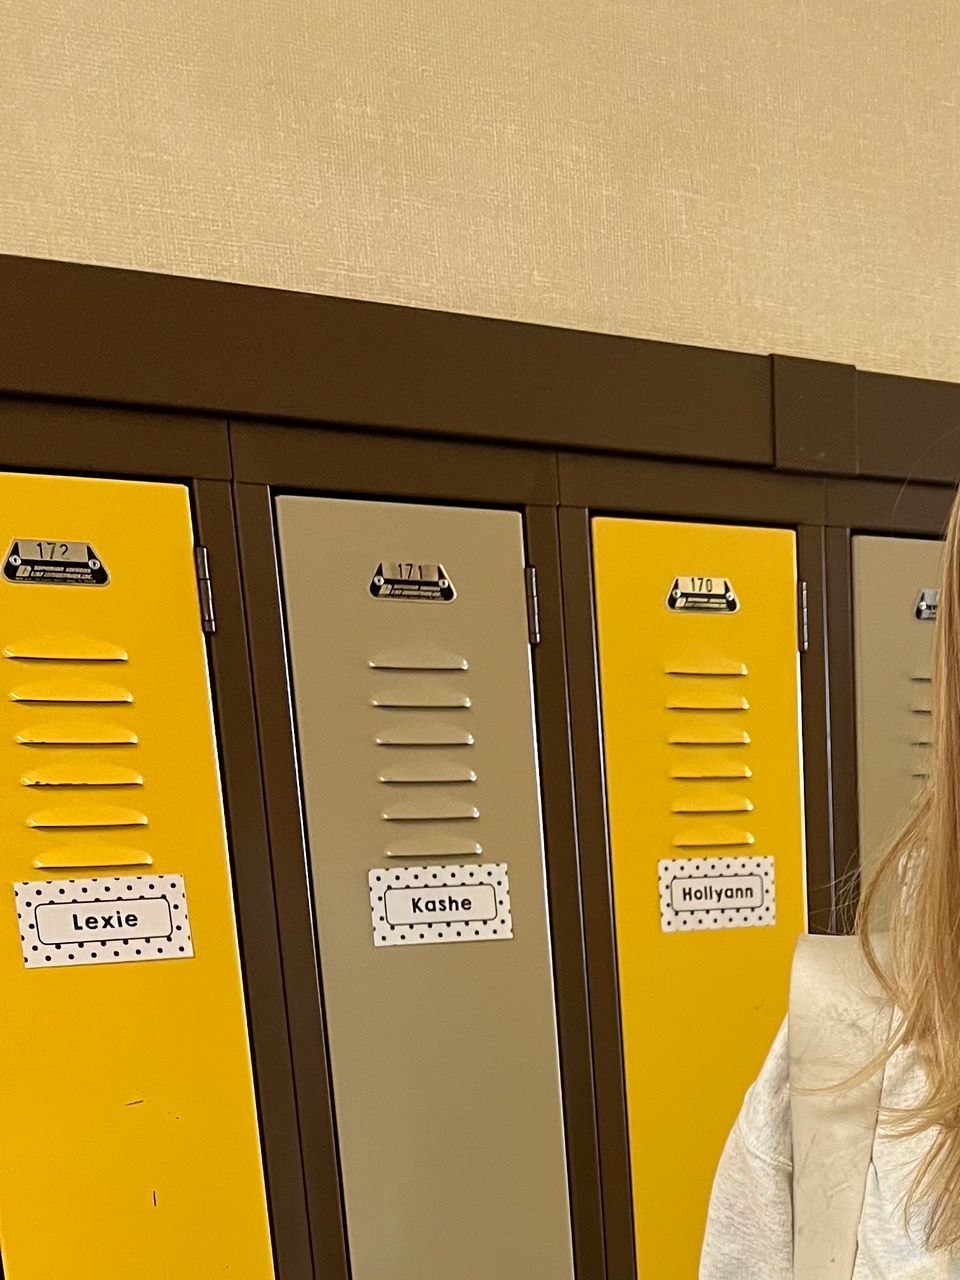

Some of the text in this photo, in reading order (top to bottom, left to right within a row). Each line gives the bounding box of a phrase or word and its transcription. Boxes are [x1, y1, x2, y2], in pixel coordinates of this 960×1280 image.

[36, 542, 69, 560] 172
[398, 563, 423, 580] 171
[691, 577, 713, 593] 170
[682, 885, 754, 903] Hollyann
[411, 895, 472, 914] Kashe
[72, 910, 138, 931] Lexie
